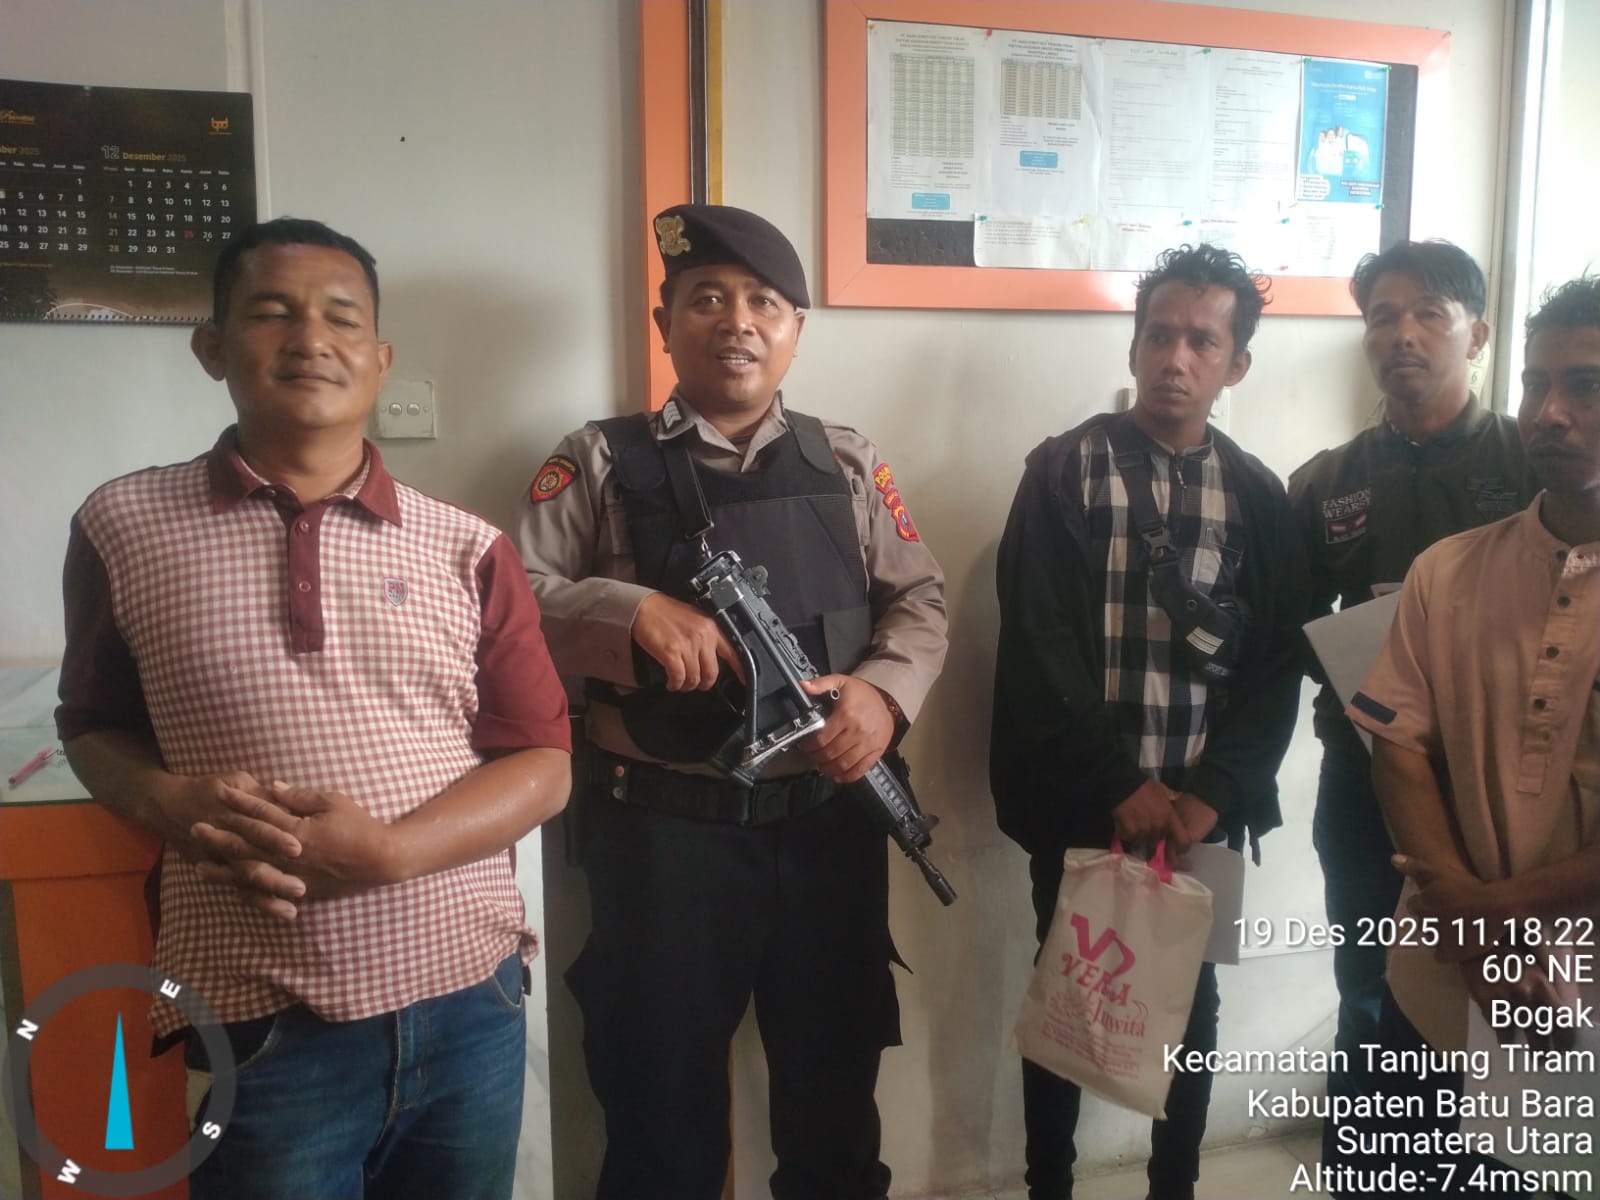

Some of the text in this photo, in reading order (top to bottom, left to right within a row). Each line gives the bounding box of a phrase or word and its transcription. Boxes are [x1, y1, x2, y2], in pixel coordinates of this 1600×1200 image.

[122, 152, 166, 161] Desember
[77, 177, 82, 185] 1
[147, 180, 152, 188] 2
[166, 181, 172, 189] 3
[203, 182, 209, 191] 5
[221, 183, 227, 191] 6
[18, 191, 84, 202] 5 6 7 8
[128, 196, 134, 204] 8
[147, 197, 153, 205] 9
[164, 197, 174, 205] 10
[183, 198, 192, 206] 11
[201, 199, 211, 207] 12
[220, 199, 230, 207] 13
[17, 208, 27, 217] 12
[37, 209, 47, 217] 13
[57, 210, 67, 218] 14
[76, 210, 87, 219] 15
[108, 212, 118, 220] 14
[127, 212, 137, 221] 15
[146, 213, 156, 221] 16
[183, 214, 193, 222] 18
[202, 215, 212, 223] 19
[220, 215, 231, 224] 20
[18, 225, 28, 233] 19
[37, 225, 49, 234] 20
[58, 226, 67, 235] 21
[77, 227, 87, 235] 22
[108, 228, 118, 236] 21
[127, 228, 137, 237] 22
[146, 229, 156, 237] 23
[165, 230, 176, 238] 24
[202, 231, 213, 240] 26
[221, 231, 231, 240] 27
[18, 241, 30, 249] 26
[39, 242, 49, 250] 27
[58, 242, 69, 251] 28
[77, 243, 88, 251] 29
[109, 244, 176, 254] 28 29 30 31
